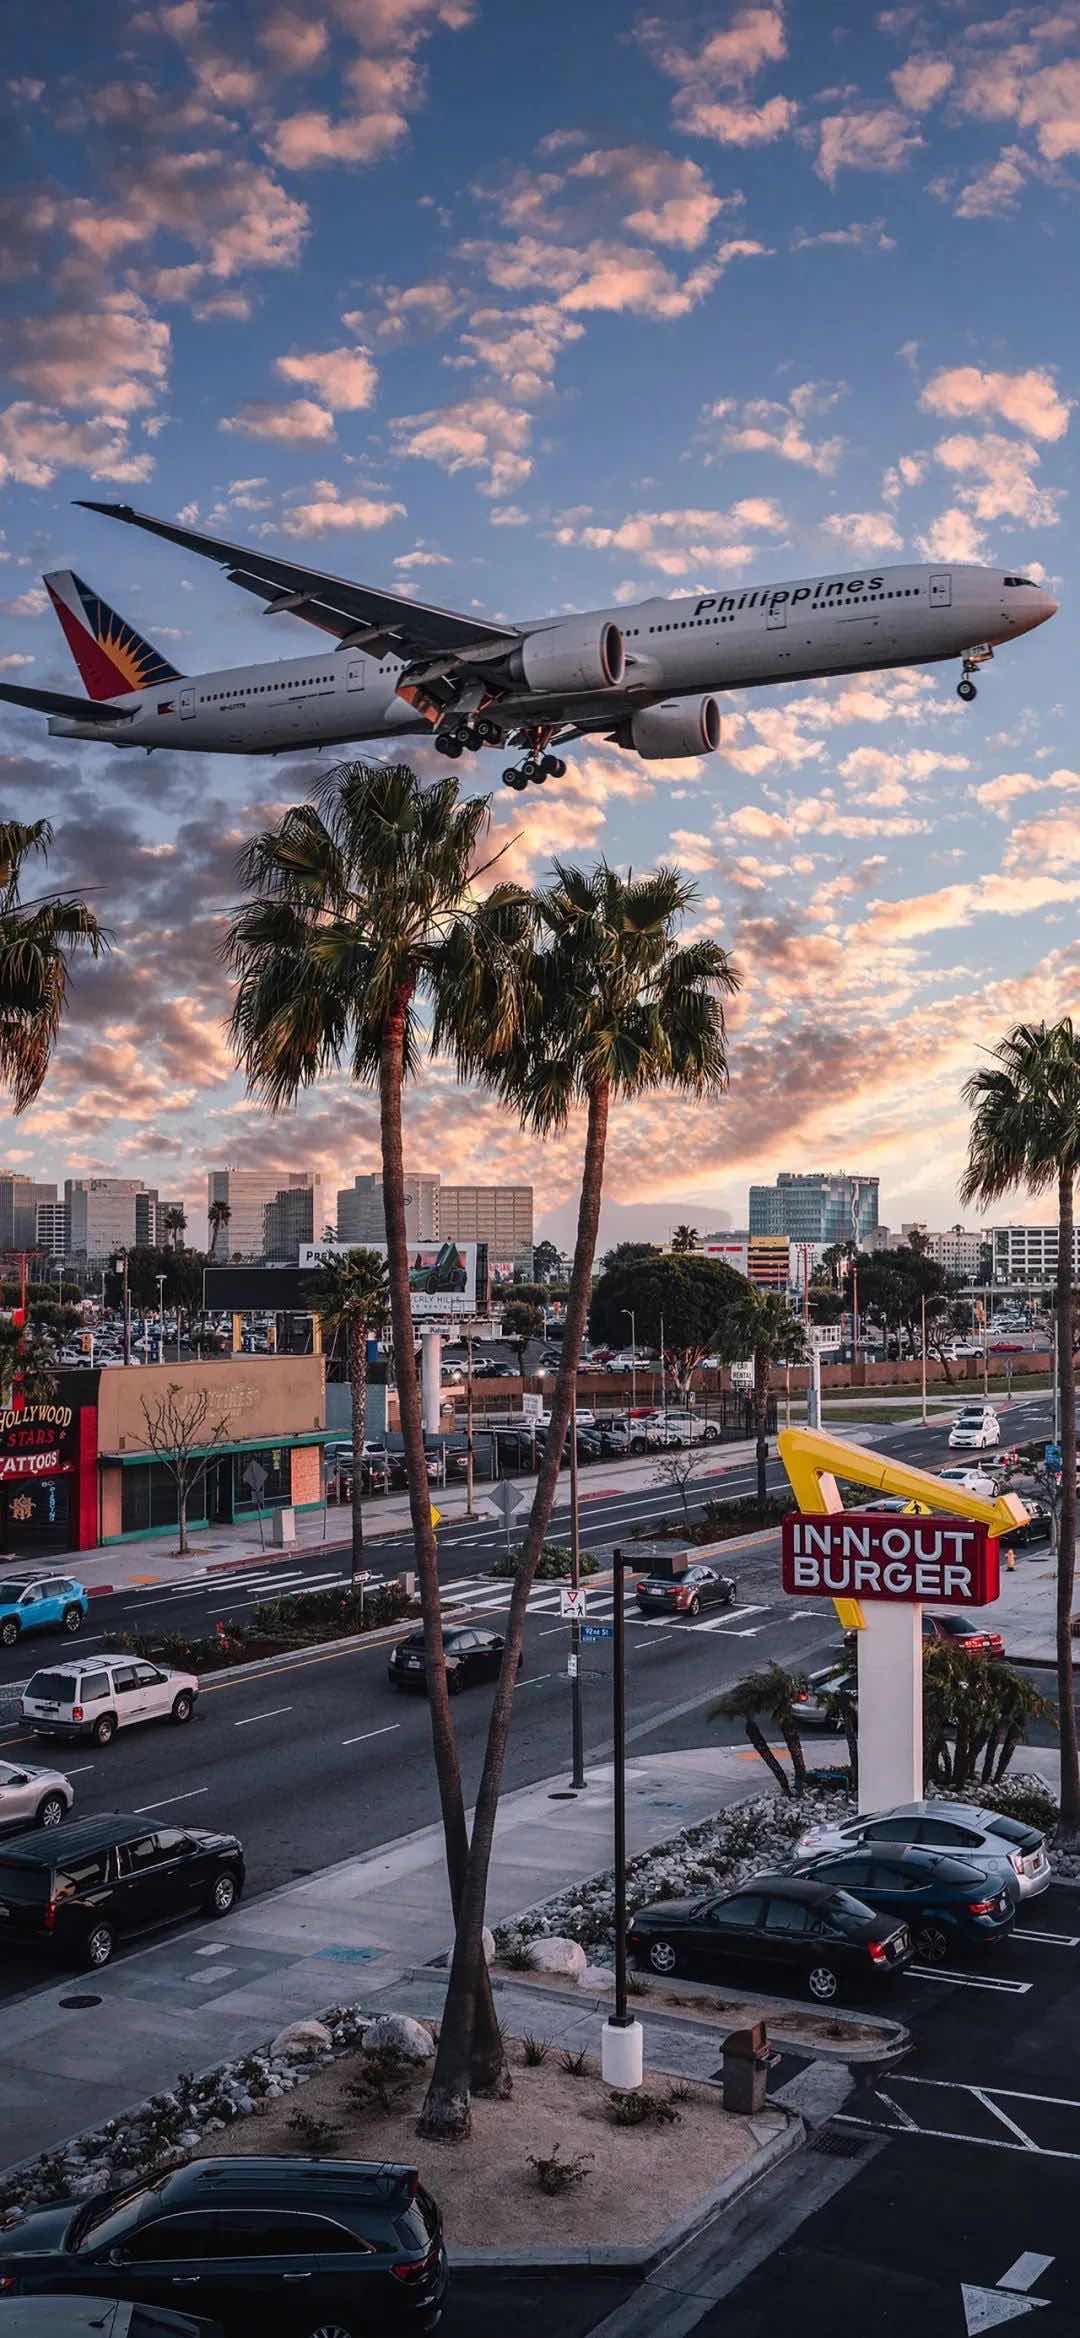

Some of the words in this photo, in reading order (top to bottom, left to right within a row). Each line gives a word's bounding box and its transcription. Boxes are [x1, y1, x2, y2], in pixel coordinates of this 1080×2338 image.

[694, 576, 884, 616] Philippines
[8, 1429, 55, 1448] STARS
[793, 1524, 974, 1563] IN-N-OUT
[793, 1556, 972, 1597] BURGER
